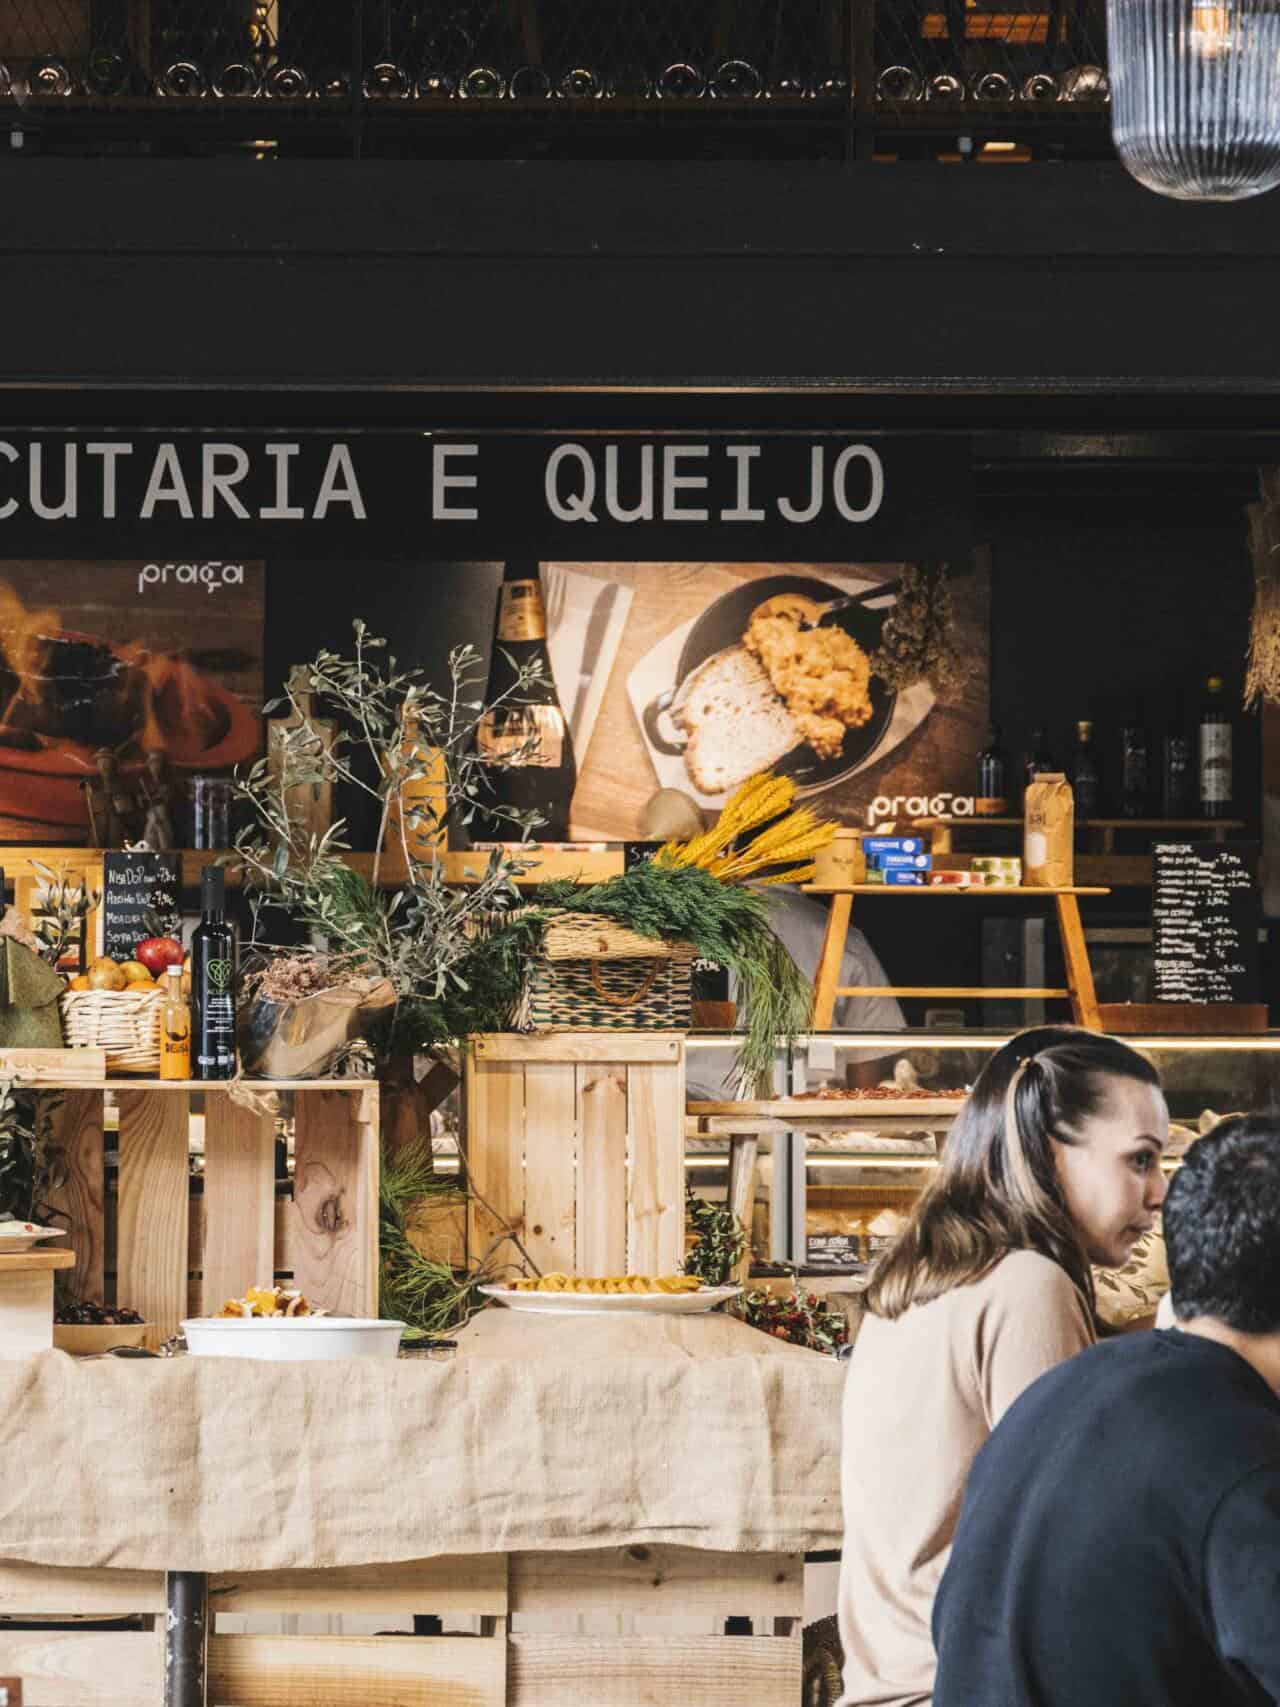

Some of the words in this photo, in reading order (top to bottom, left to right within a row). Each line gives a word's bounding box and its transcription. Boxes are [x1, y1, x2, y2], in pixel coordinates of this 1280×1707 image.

[431, 443, 479, 521] E
[544, 442, 885, 524] QUEIJO
[138, 561, 244, 594] praça
